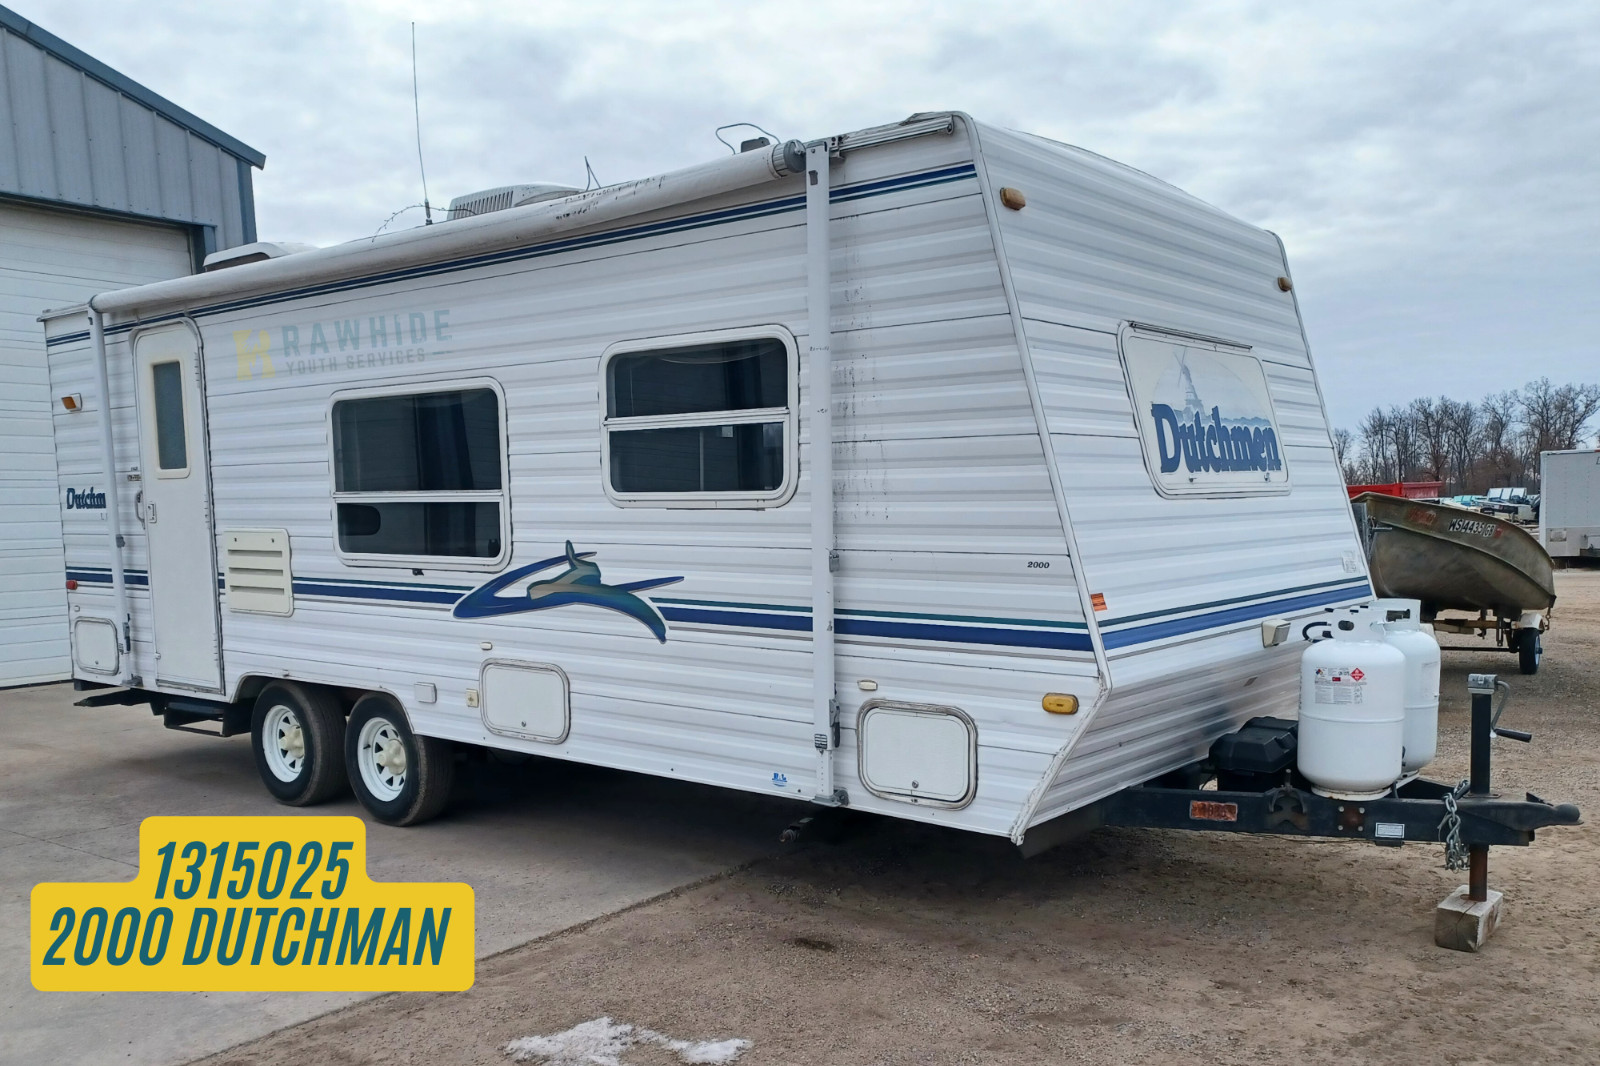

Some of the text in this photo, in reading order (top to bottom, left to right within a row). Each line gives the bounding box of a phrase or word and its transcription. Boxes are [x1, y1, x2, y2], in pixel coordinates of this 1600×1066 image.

[281, 309, 453, 358] RAWHIDE
[286, 348, 425, 376] YOUTH SERVICES
[1151, 403, 1282, 473] Dutchmen
[66, 486, 107, 510] Dutchm
[1027, 561, 1050, 569] 2000
